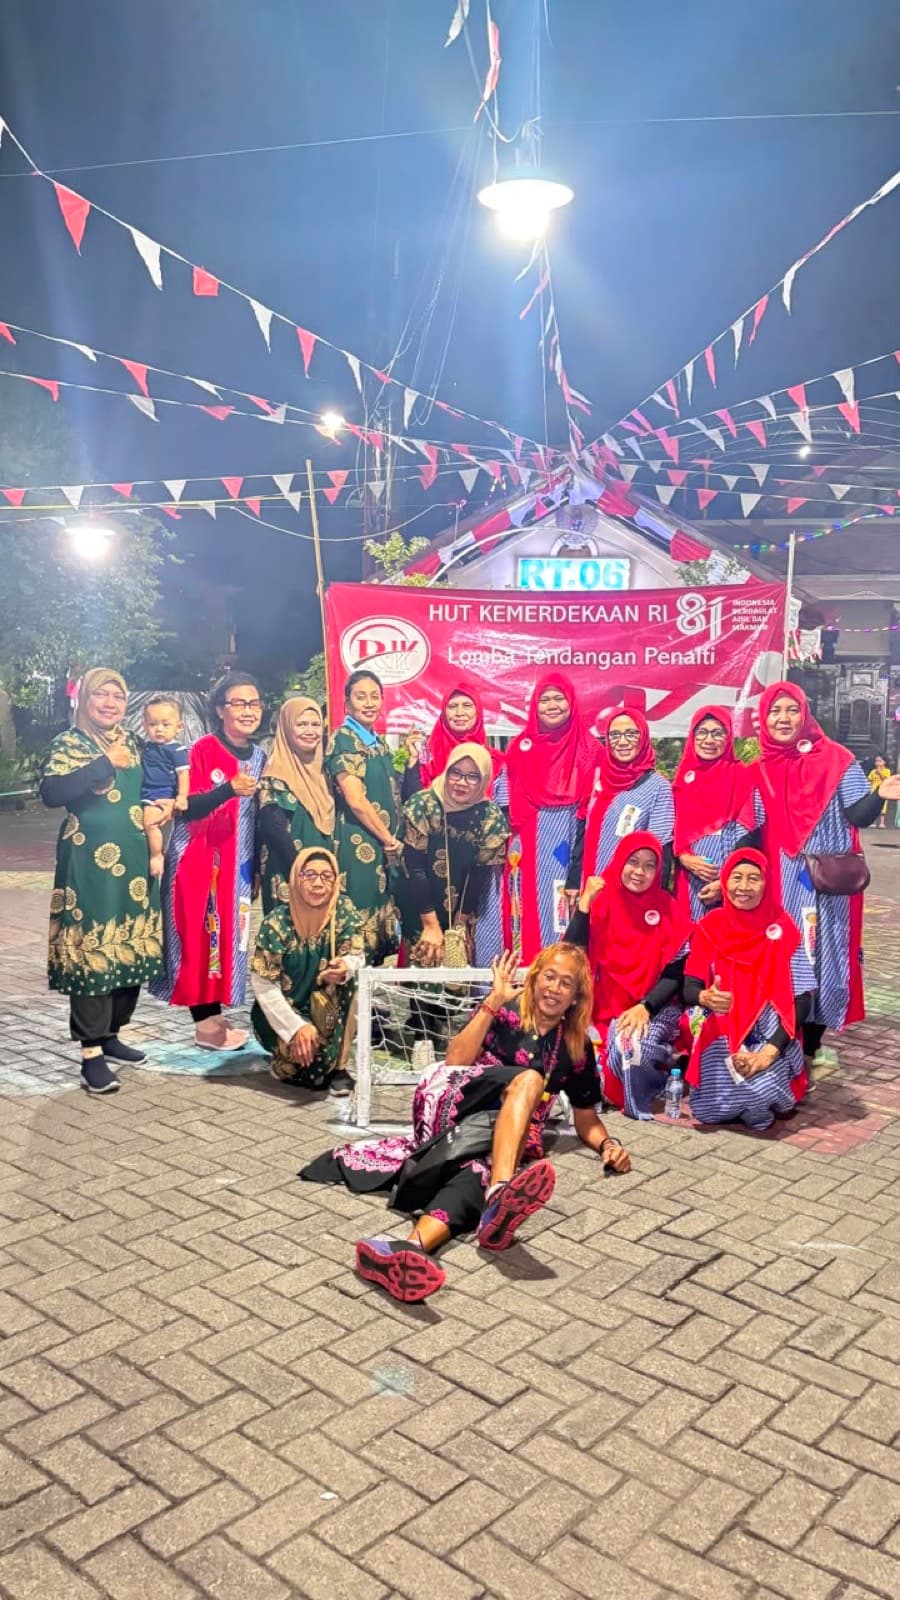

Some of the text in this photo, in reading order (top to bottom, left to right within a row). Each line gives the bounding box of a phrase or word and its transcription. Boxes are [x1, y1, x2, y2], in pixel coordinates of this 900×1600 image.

[520, 559, 625, 589] RT.06
[429, 604, 668, 623] HUT KEMERDEKAAN RI
[676, 592, 727, 641] 81
[447, 646, 715, 670] Lomba Tendangan Penalti
